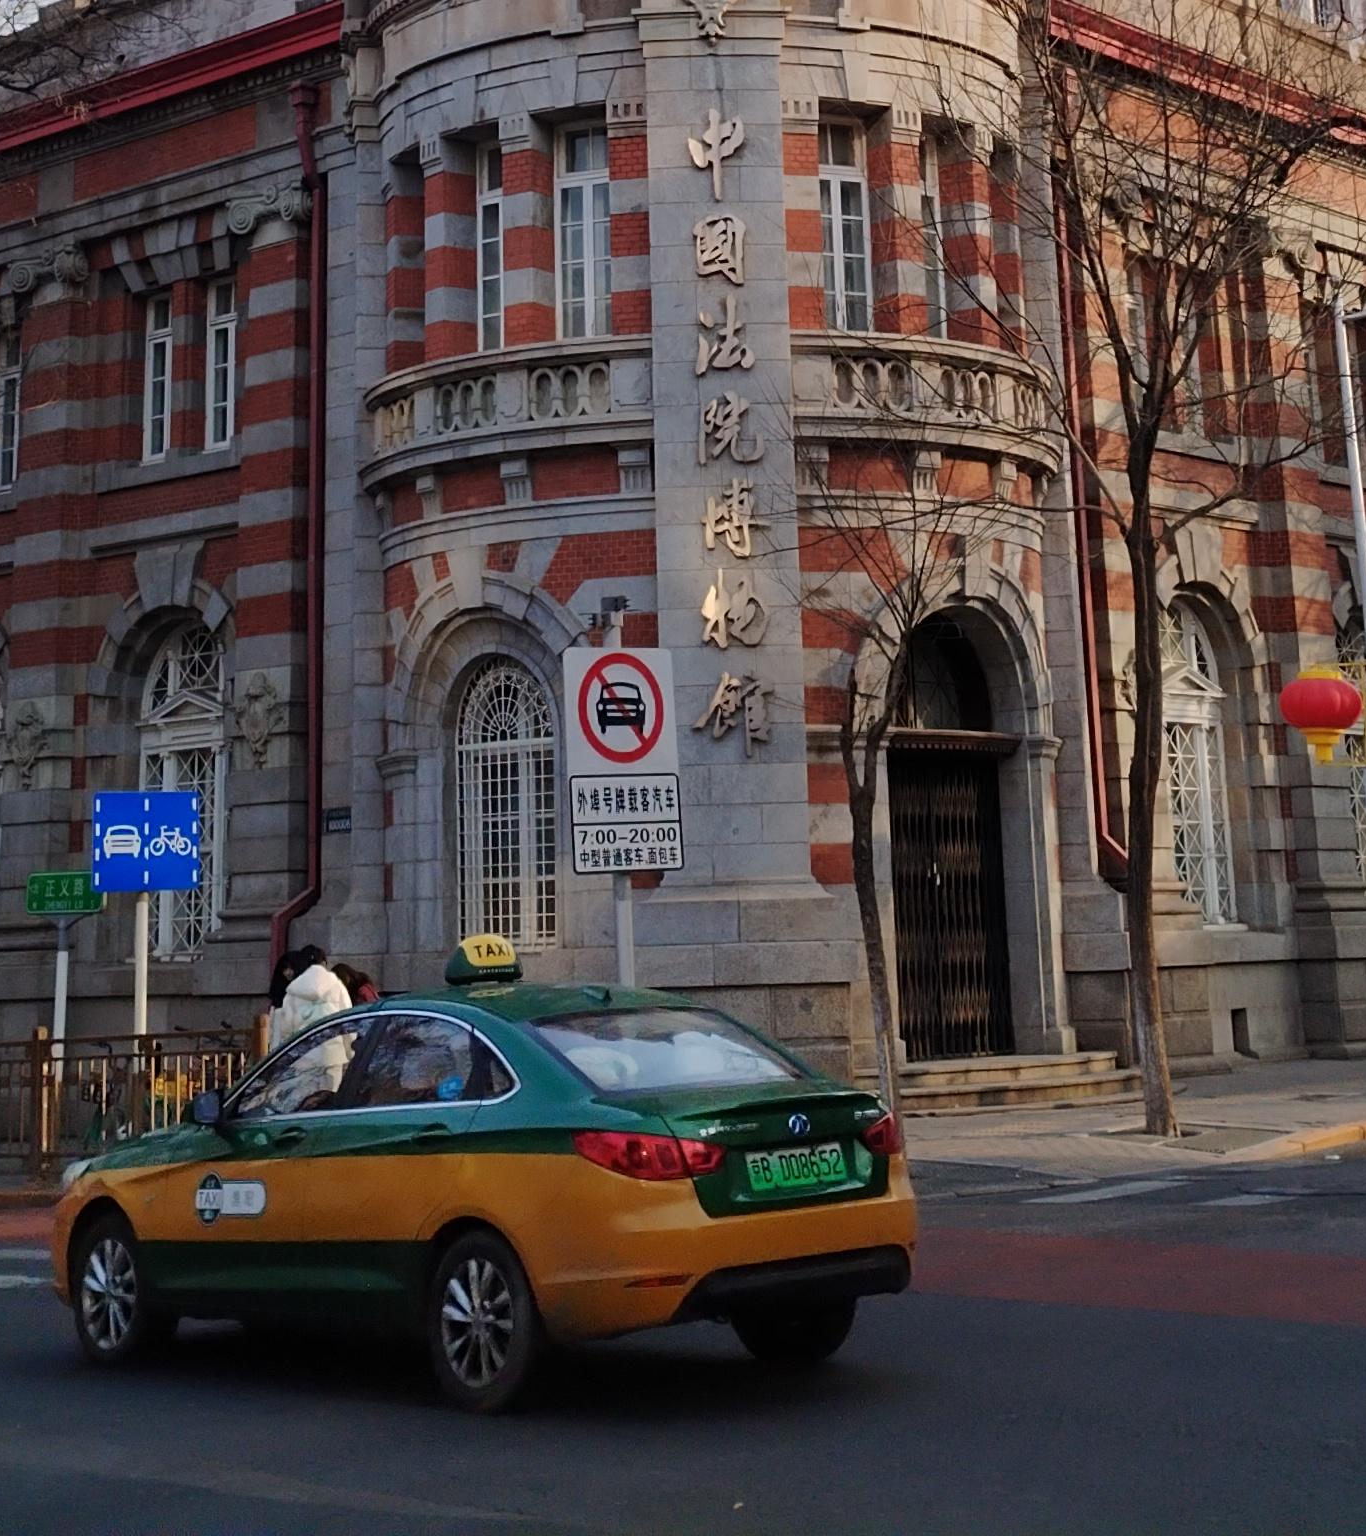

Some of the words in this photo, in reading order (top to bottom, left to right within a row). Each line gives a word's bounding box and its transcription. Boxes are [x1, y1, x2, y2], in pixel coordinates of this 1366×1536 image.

[577, 785, 675, 815] 外埠号牌载客汽车
[44, 878, 84, 897] 正义路
[473, 943, 511, 959] TAXI
[198, 1191, 220, 1206] TAX
